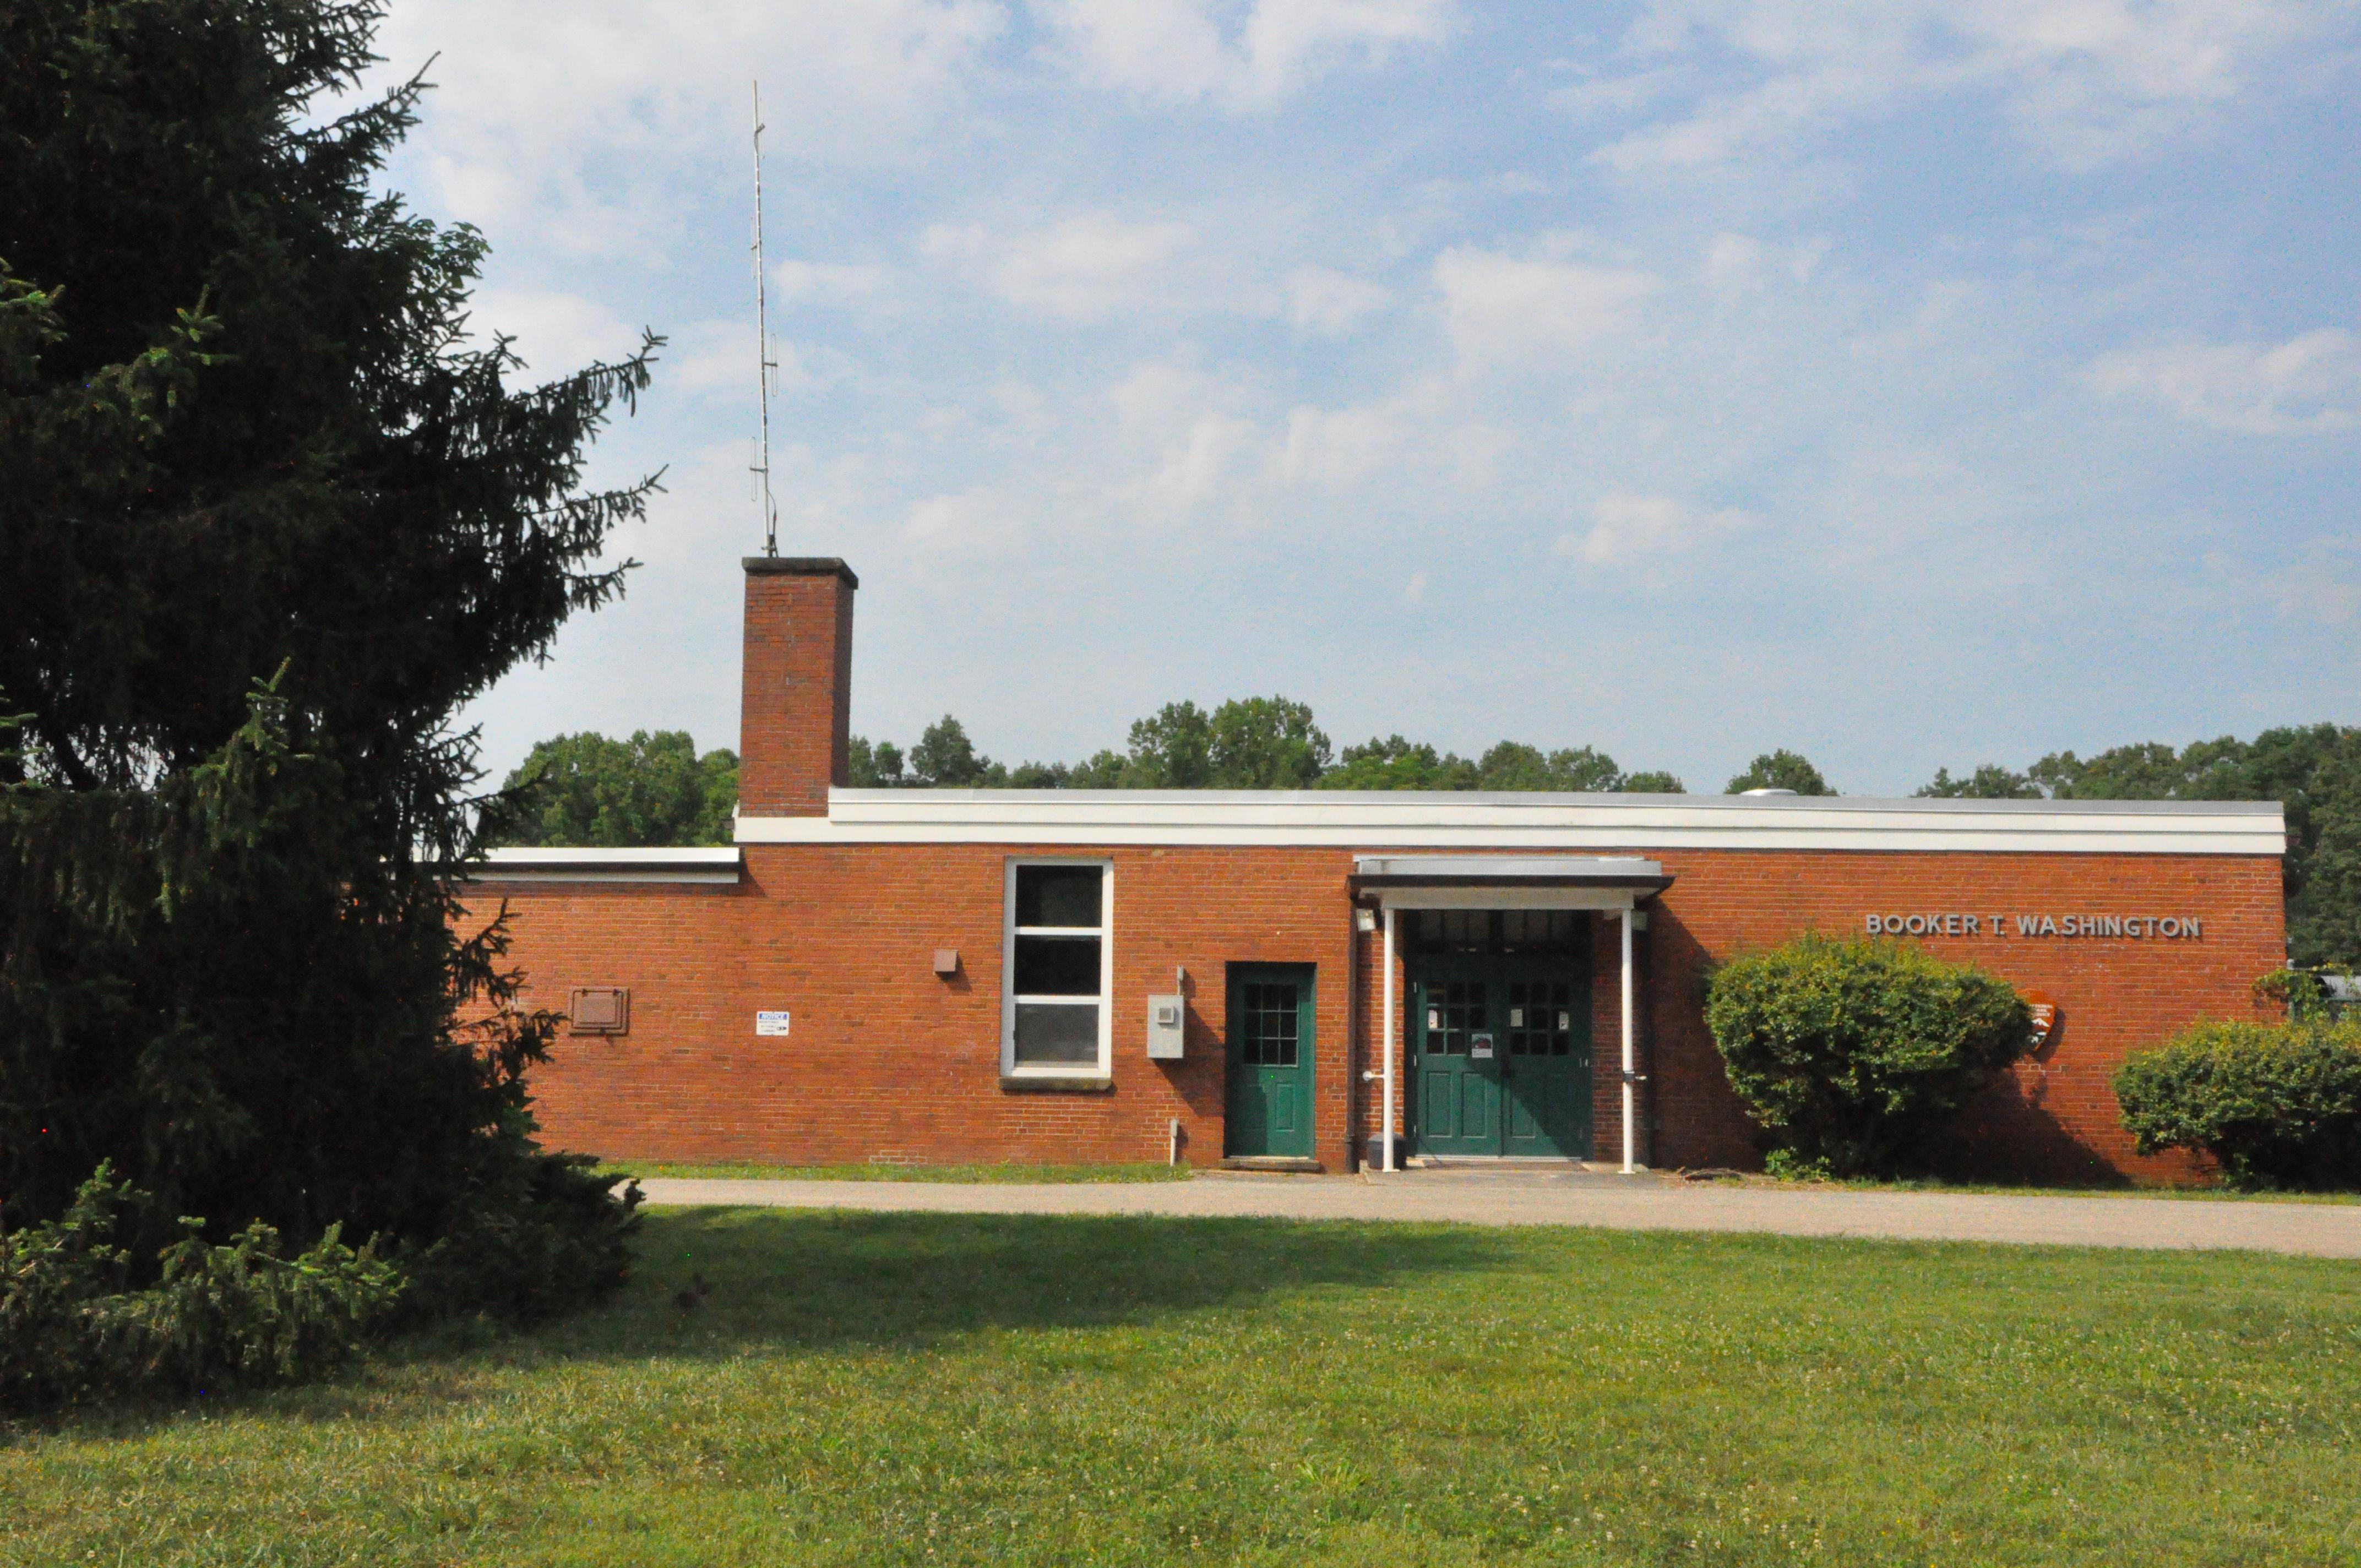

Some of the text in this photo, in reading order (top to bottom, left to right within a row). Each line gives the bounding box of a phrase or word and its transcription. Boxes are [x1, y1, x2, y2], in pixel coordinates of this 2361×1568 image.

[1866, 914, 2199, 936] BOOKER T. WASHINGTON
